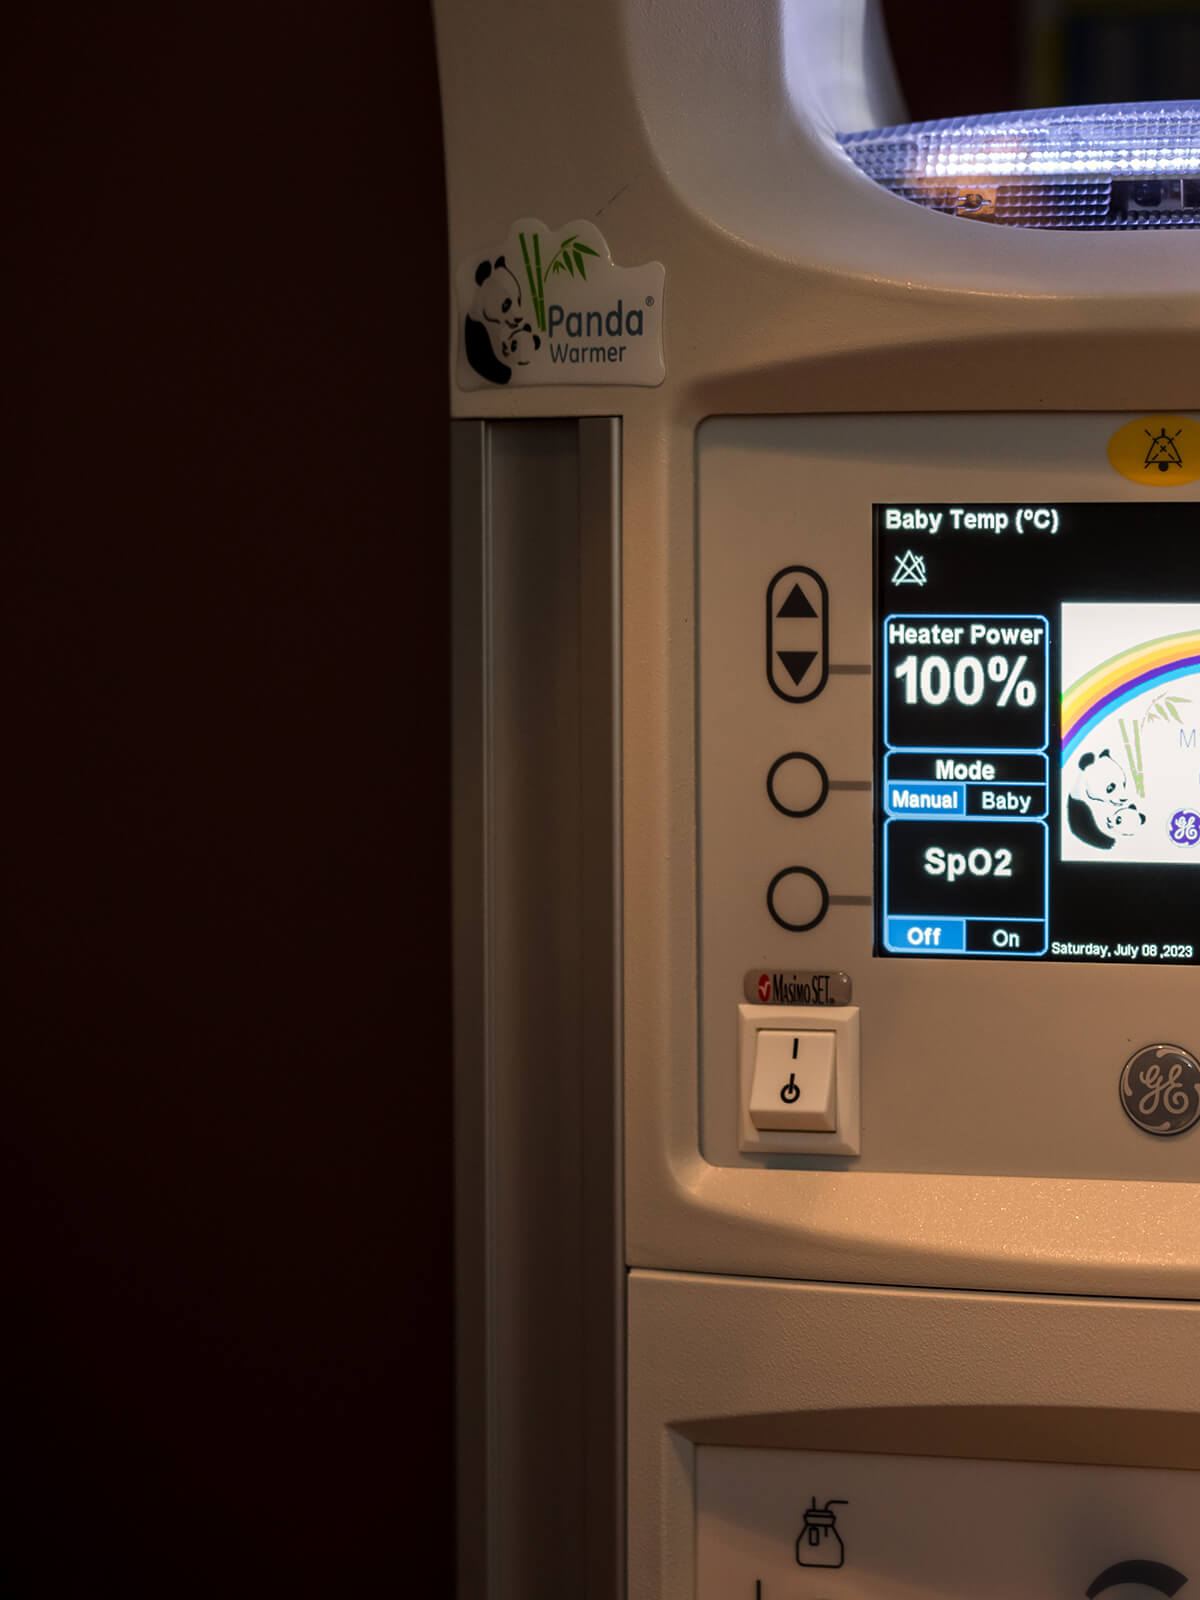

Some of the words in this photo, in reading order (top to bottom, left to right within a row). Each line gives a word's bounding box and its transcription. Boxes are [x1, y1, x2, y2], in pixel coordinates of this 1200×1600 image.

[550, 344, 626, 363] Warmer
[885, 508, 942, 533] Baby
[950, 509, 1008, 533] Temp
[888, 624, 964, 645] Heater
[970, 624, 1043, 645] Power
[894, 655, 1037, 707] 100%
[935, 759, 996, 780] Mode
[892, 790, 958, 809] Manual
[981, 791, 1032, 813] Baby
[923, 847, 1013, 882] SpO2
[906, 927, 942, 945] Off
[992, 929, 1020, 947] On
[1050, 942, 1112, 957] Saturday,
[1113, 943, 1139, 959] July
[1142, 945, 1157, 957] 08
